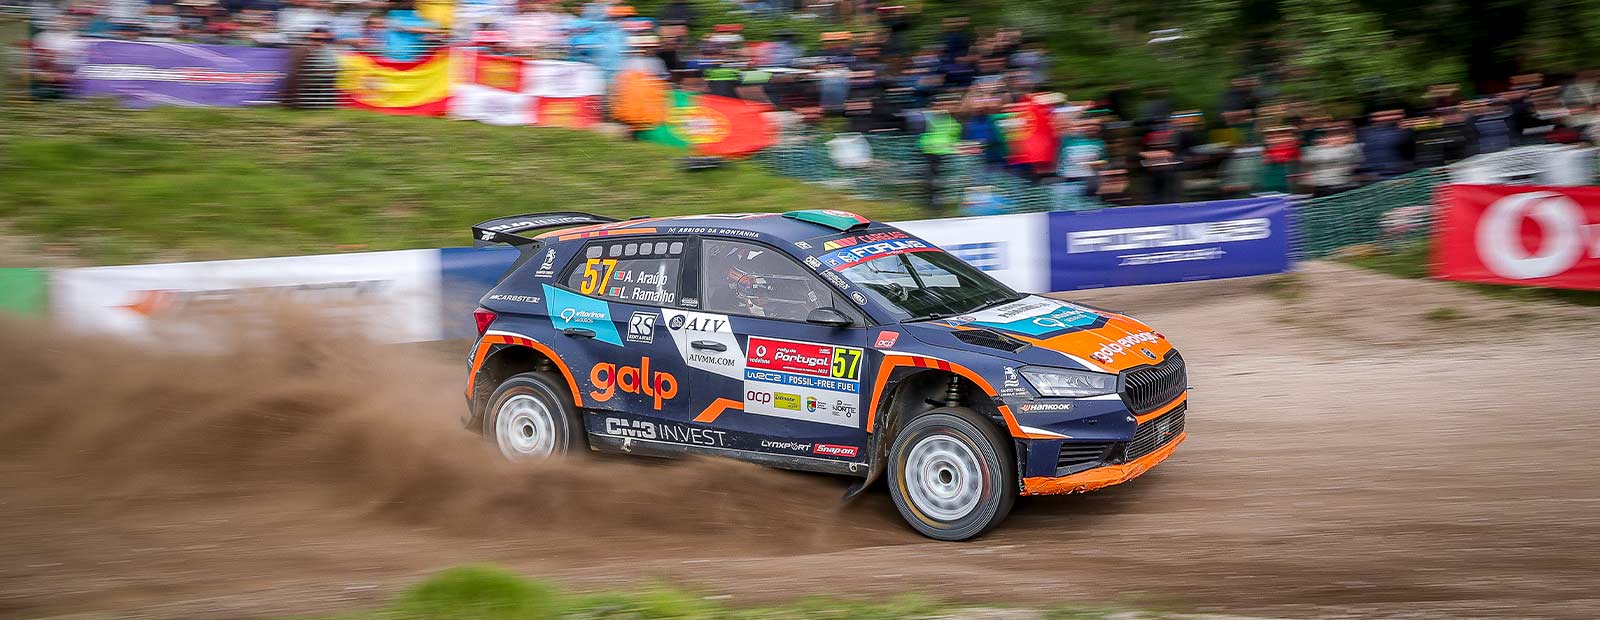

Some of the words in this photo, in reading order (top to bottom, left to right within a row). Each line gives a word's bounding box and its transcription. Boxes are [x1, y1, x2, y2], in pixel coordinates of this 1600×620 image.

[719, 228, 759, 238] MONTANHA
[580, 258, 618, 295] 57
[624, 270, 634, 283] A.
[637, 271, 668, 287] Araújo
[620, 286, 629, 299] L.
[632, 287, 675, 303] Ramalho
[632, 315, 656, 335] RS
[685, 317, 726, 333] AIV
[688, 354, 735, 367] AIVMM.COM
[774, 352, 829, 366] Portugal
[832, 348, 862, 379] 57
[589, 356, 678, 411] galp
[789, 375, 837, 389] FOSSIL-FREE
[837, 381, 856, 392] FUEL
[747, 390, 771, 404] acp
